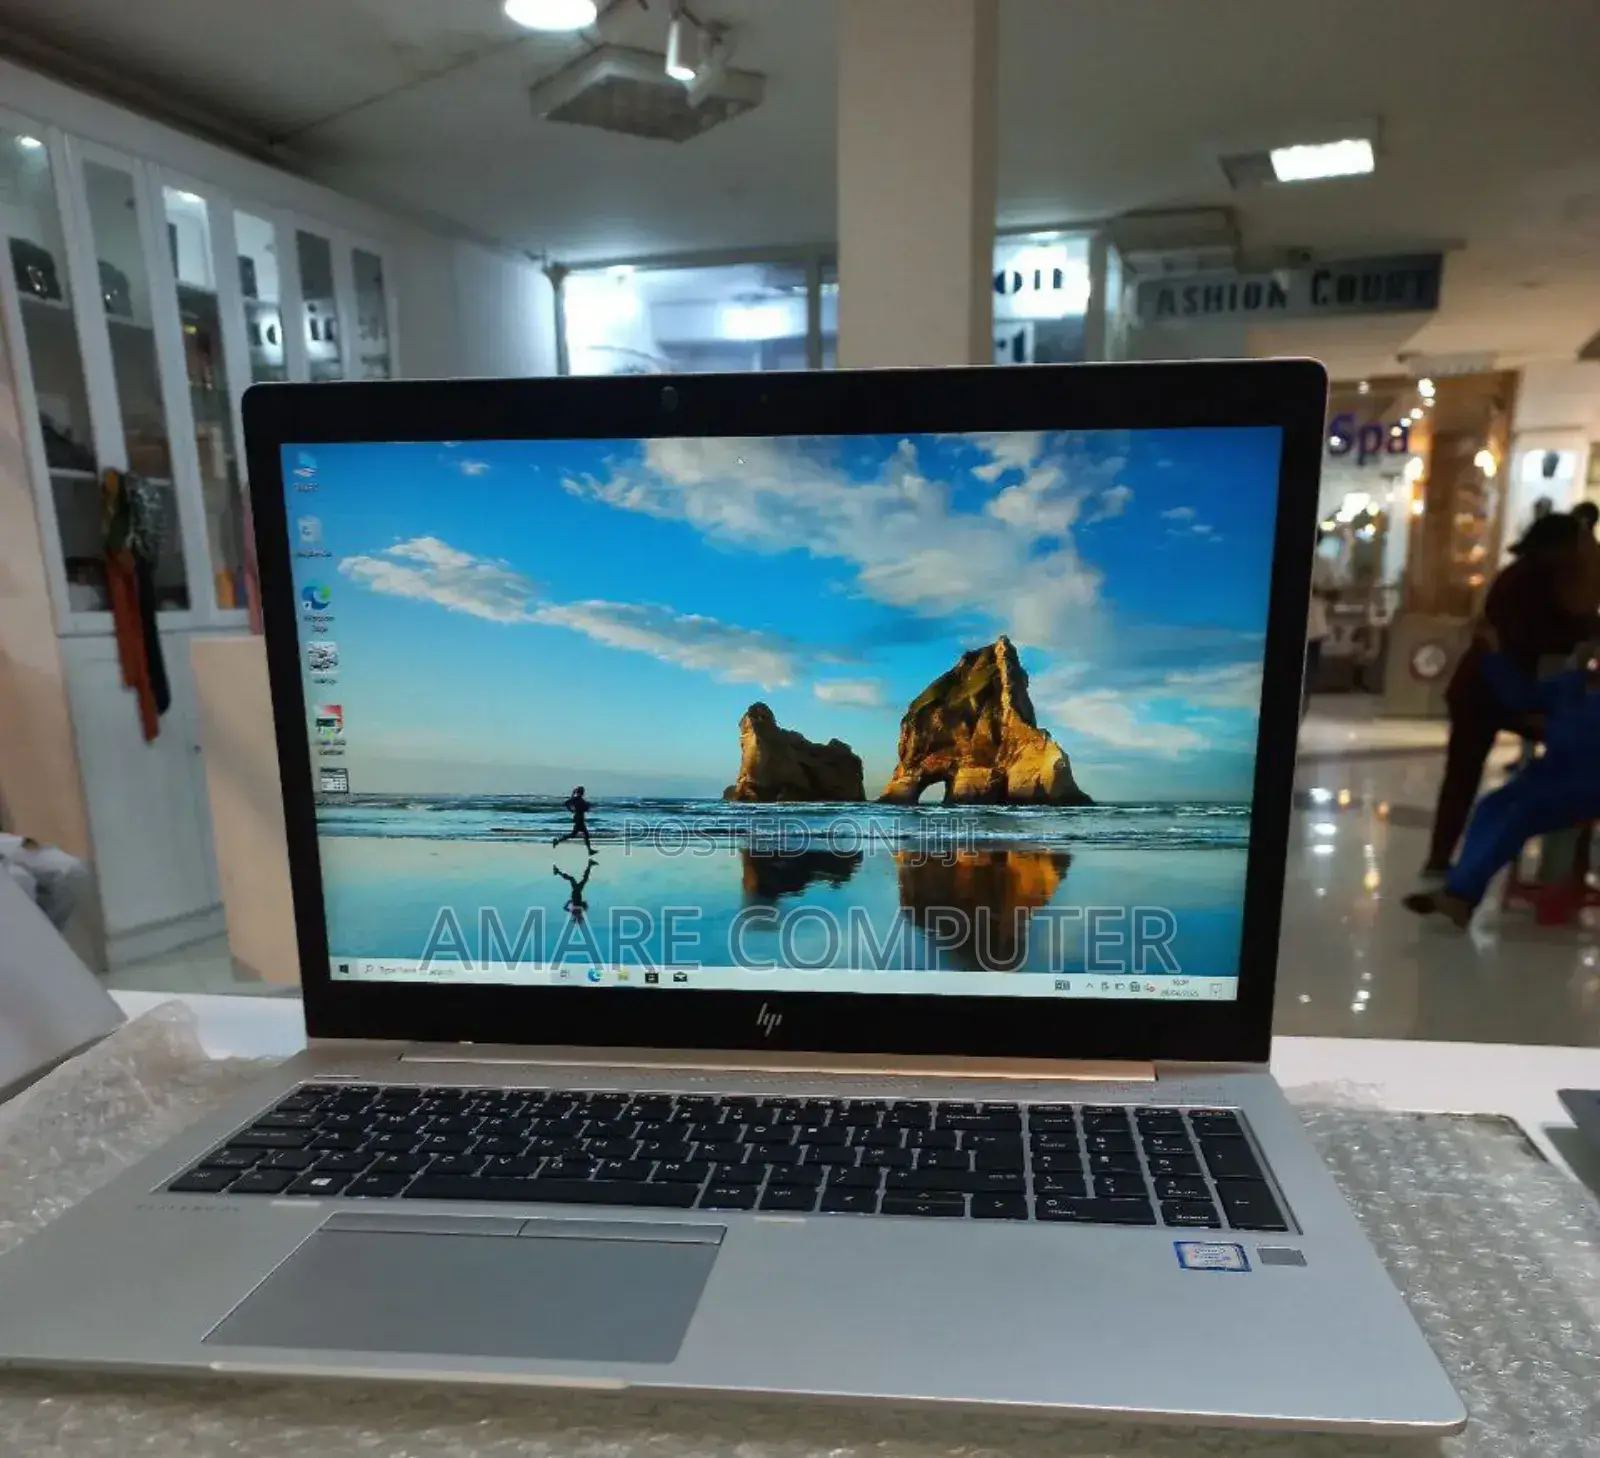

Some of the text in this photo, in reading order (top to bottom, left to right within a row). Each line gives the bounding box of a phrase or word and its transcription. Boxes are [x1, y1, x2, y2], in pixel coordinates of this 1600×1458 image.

[1138, 276, 1287, 317] ASHION
[1329, 411, 1409, 466] Spa
[756, 1002, 783, 1038] hp
